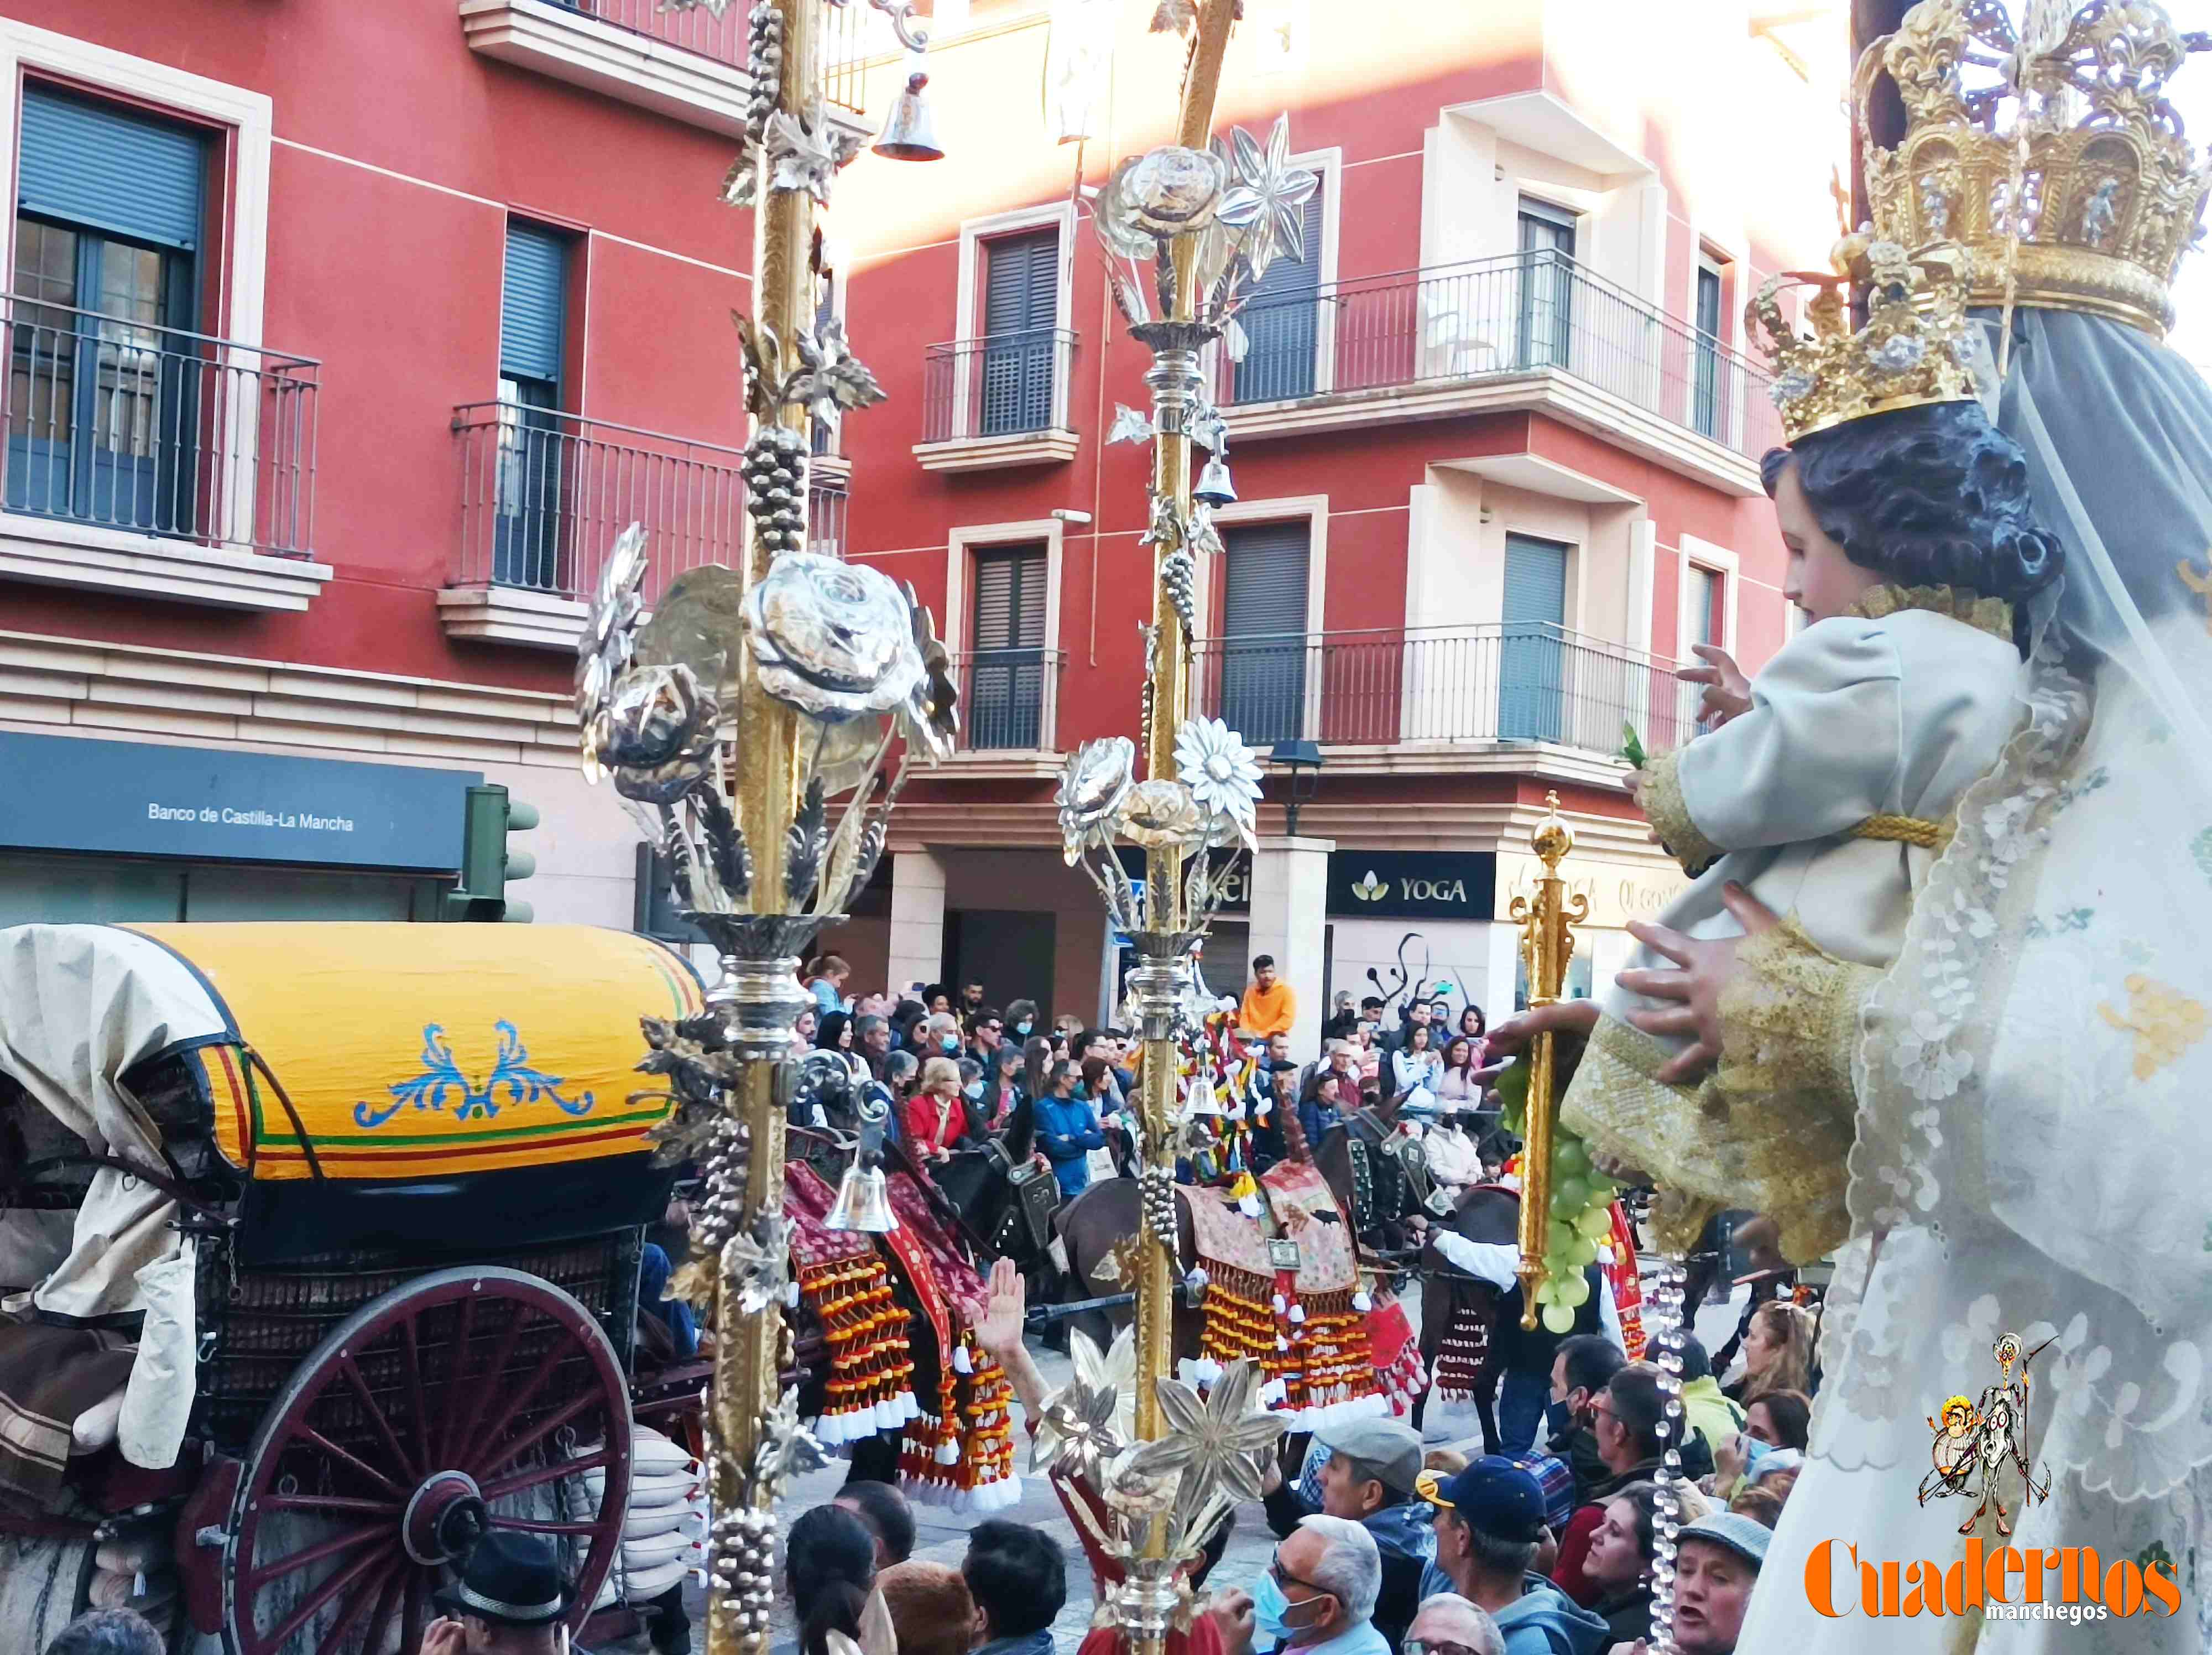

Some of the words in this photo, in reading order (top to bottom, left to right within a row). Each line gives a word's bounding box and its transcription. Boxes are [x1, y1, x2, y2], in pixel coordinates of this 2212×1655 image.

[148, 803, 195, 821] Banco
[199, 806, 218, 823] de
[222, 808, 295, 828] Castilla-La
[299, 813, 354, 831] Mancha
[1400, 878, 1467, 902] YOGA
